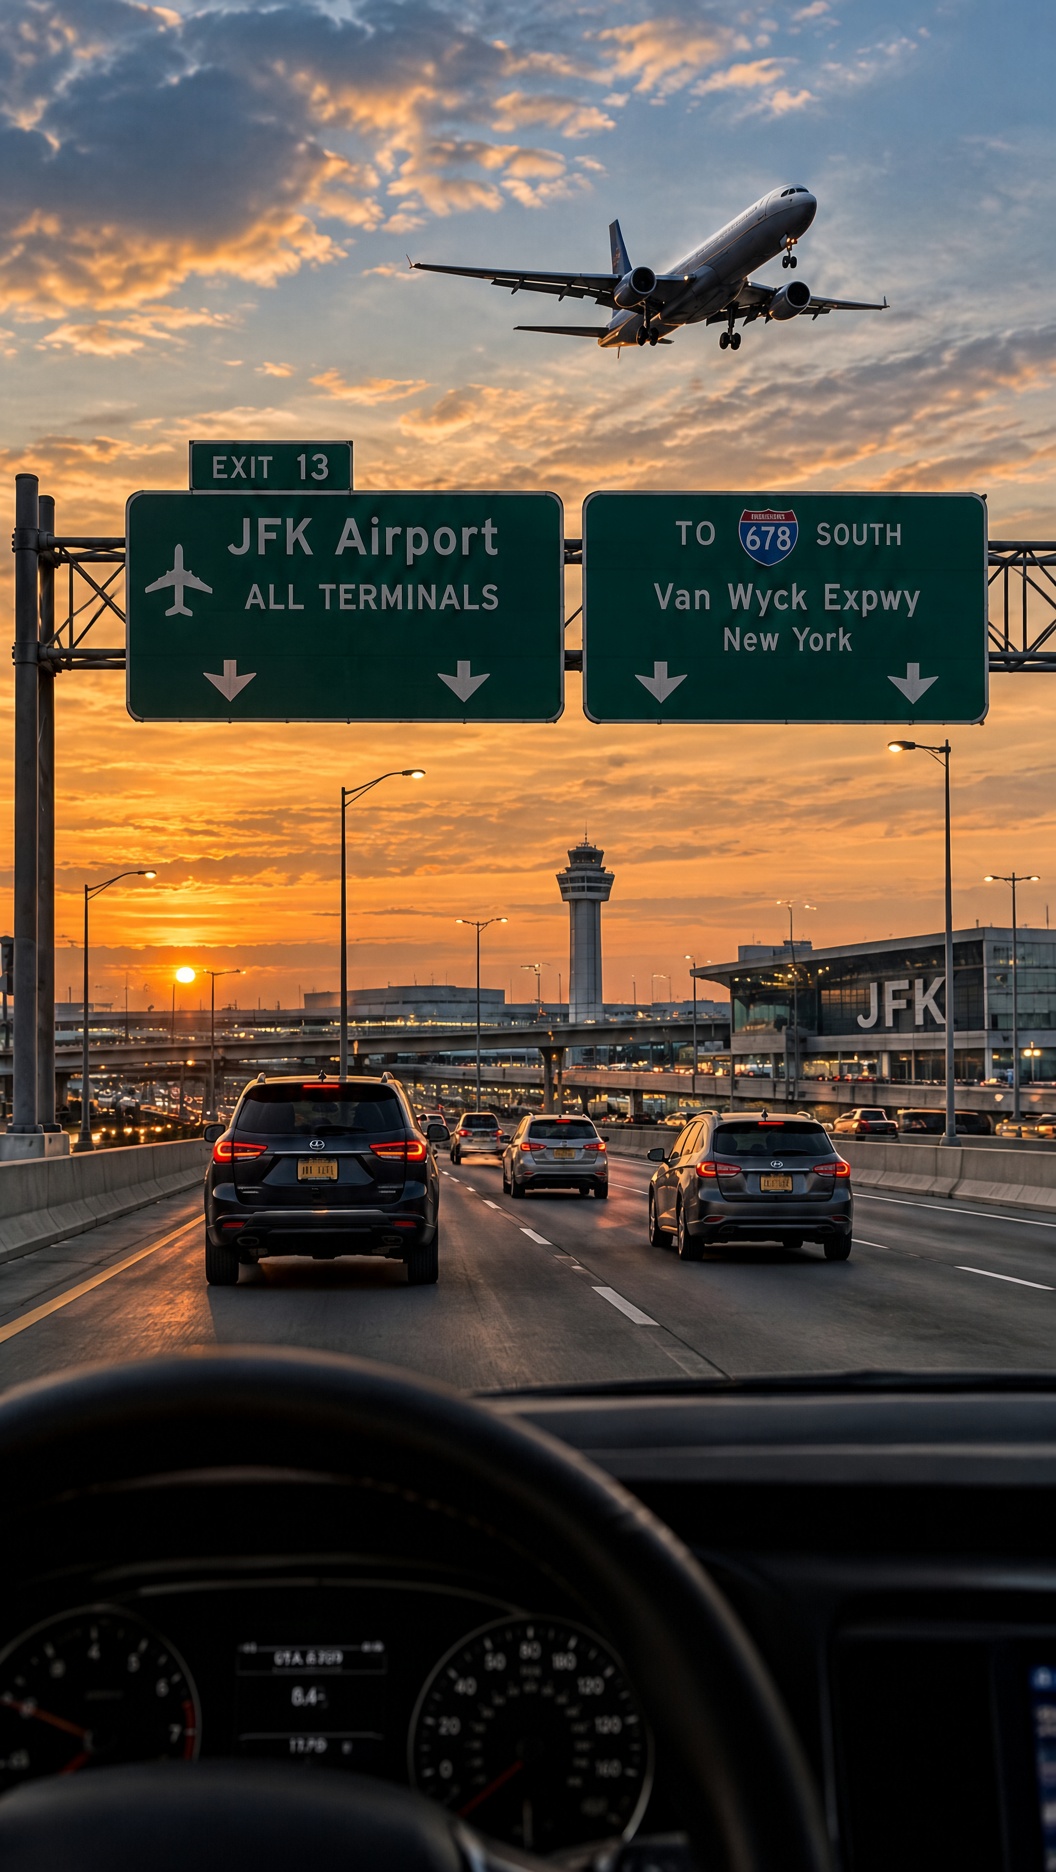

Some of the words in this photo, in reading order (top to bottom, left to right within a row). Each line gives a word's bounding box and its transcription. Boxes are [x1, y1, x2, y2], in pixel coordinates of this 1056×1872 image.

[212, 456, 273, 479] EXIT
[296, 453, 329, 481] 13
[227, 517, 314, 555] JFK
[334, 517, 498, 566] Airport
[675, 520, 716, 546] TO
[745, 525, 791, 551] 678
[816, 522, 902, 547] SOUTH
[244, 583, 305, 610] ALL
[318, 583, 499, 611] TERMINALS
[653, 582, 711, 610] Van
[727, 582, 808, 617] Wyck
[824, 583, 921, 618] Expwy
[724, 626, 780, 652] New
[792, 626, 853, 652] York
[857, 976, 946, 1029] JFK
[438, 1715, 462, 1736] 20
[439, 1758, 454, 1779] 0
